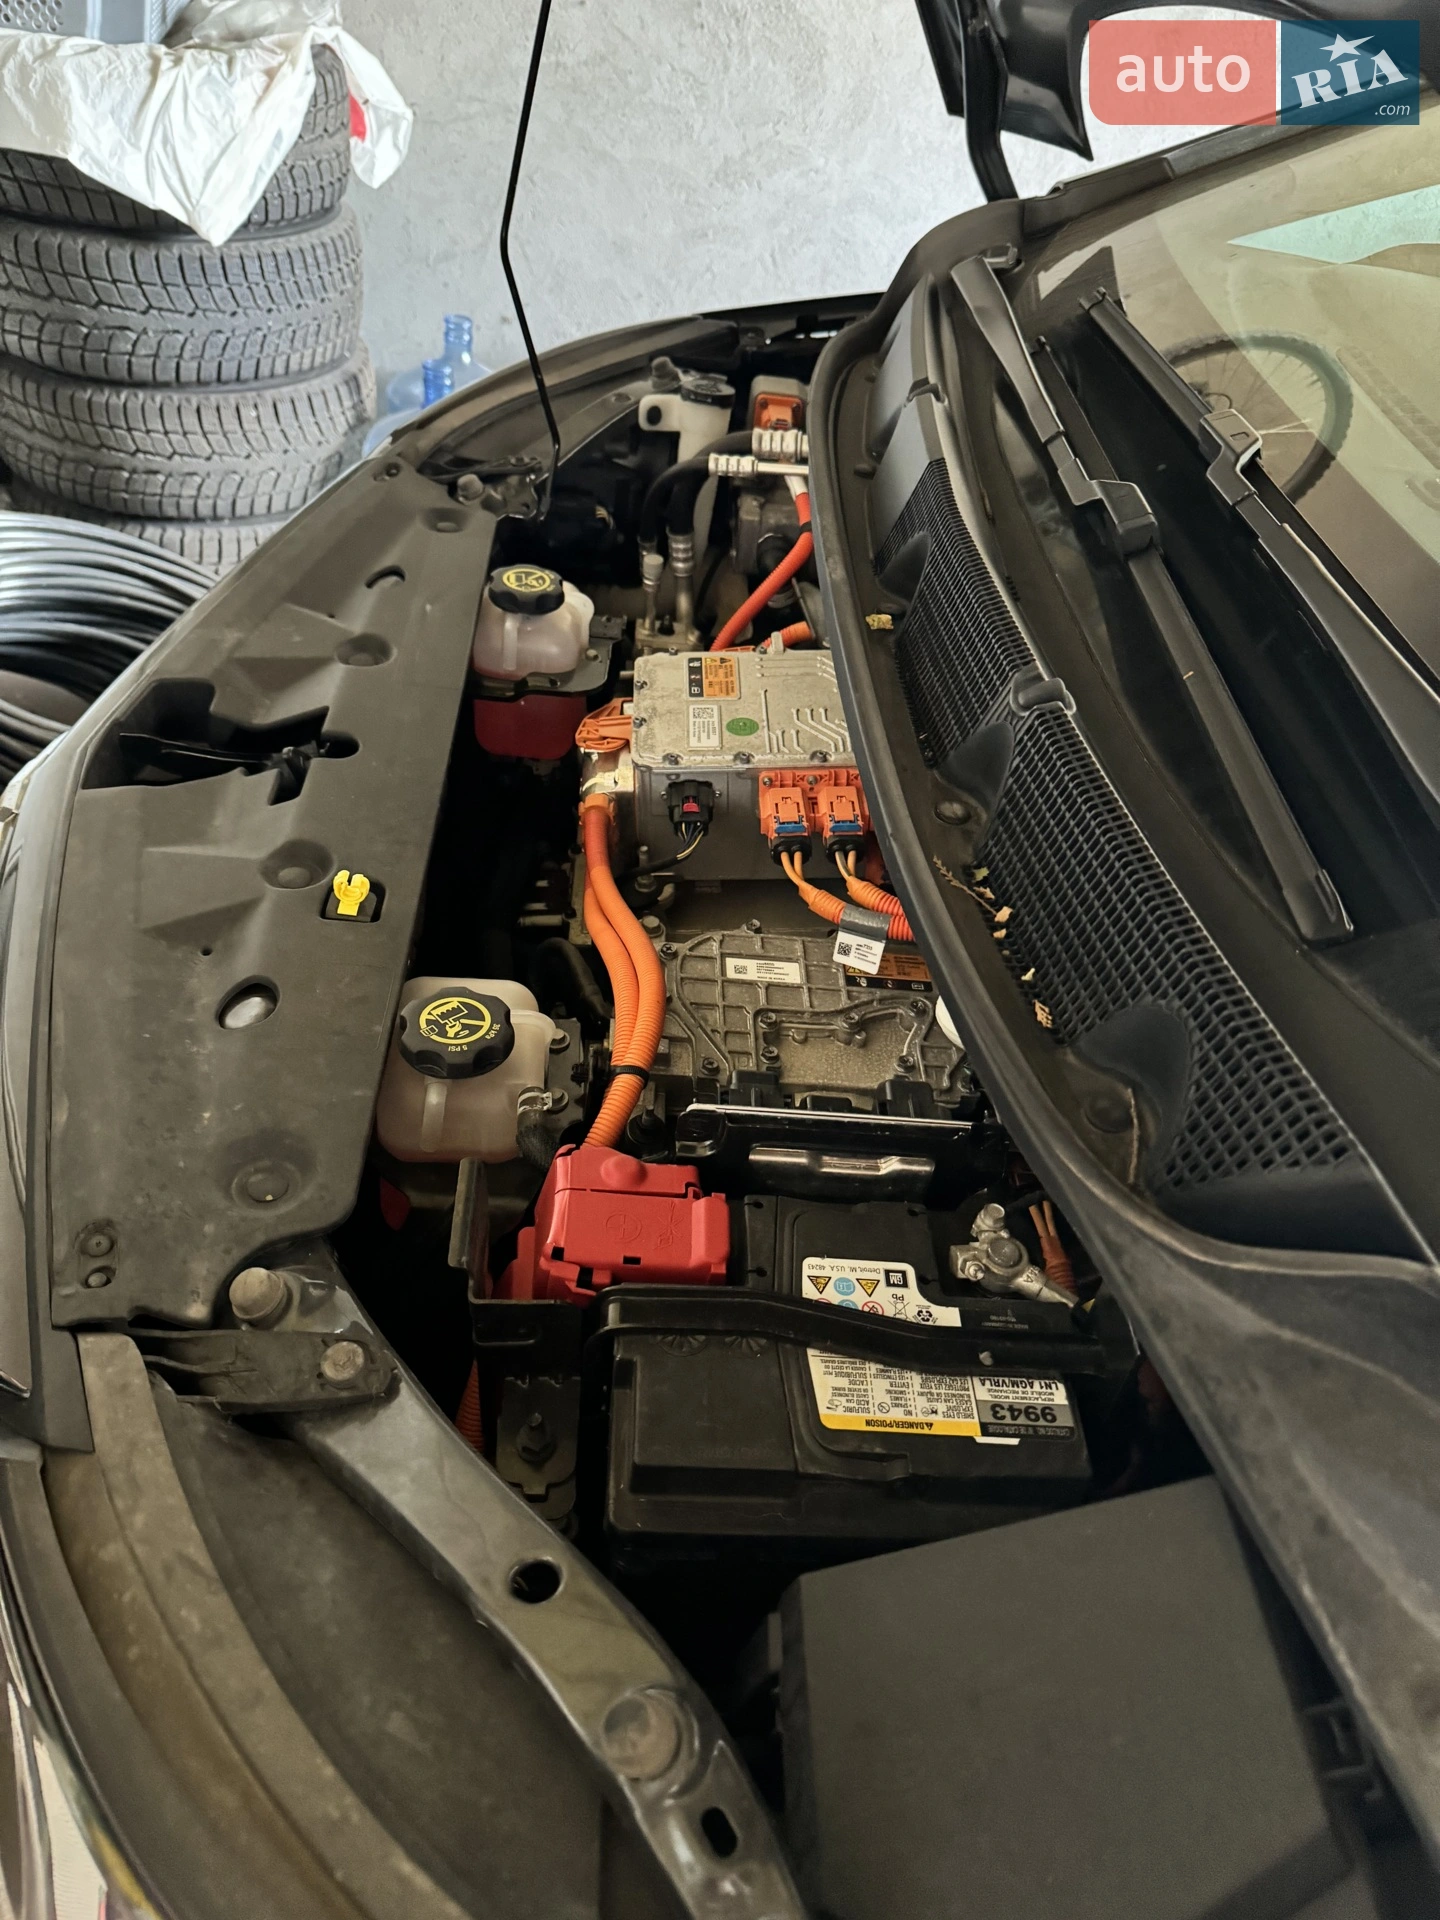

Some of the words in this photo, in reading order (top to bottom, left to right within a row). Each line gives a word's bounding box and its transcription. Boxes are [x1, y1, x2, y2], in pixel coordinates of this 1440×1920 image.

[808, 1263, 826, 1271] 48243
[858, 1266, 880, 1274] Detroit,
[889, 1273, 903, 1285] GM
[834, 1371, 867, 1379] SULFURIQUE
[979, 1378, 1034, 1389] AGM/VRLA
[1039, 1381, 1058, 1390] LN1
[842, 1405, 870, 1414] SULFURIC
[990, 1403, 1057, 1424] 9943
[865, 1419, 924, 1430] DANGER/POISON
